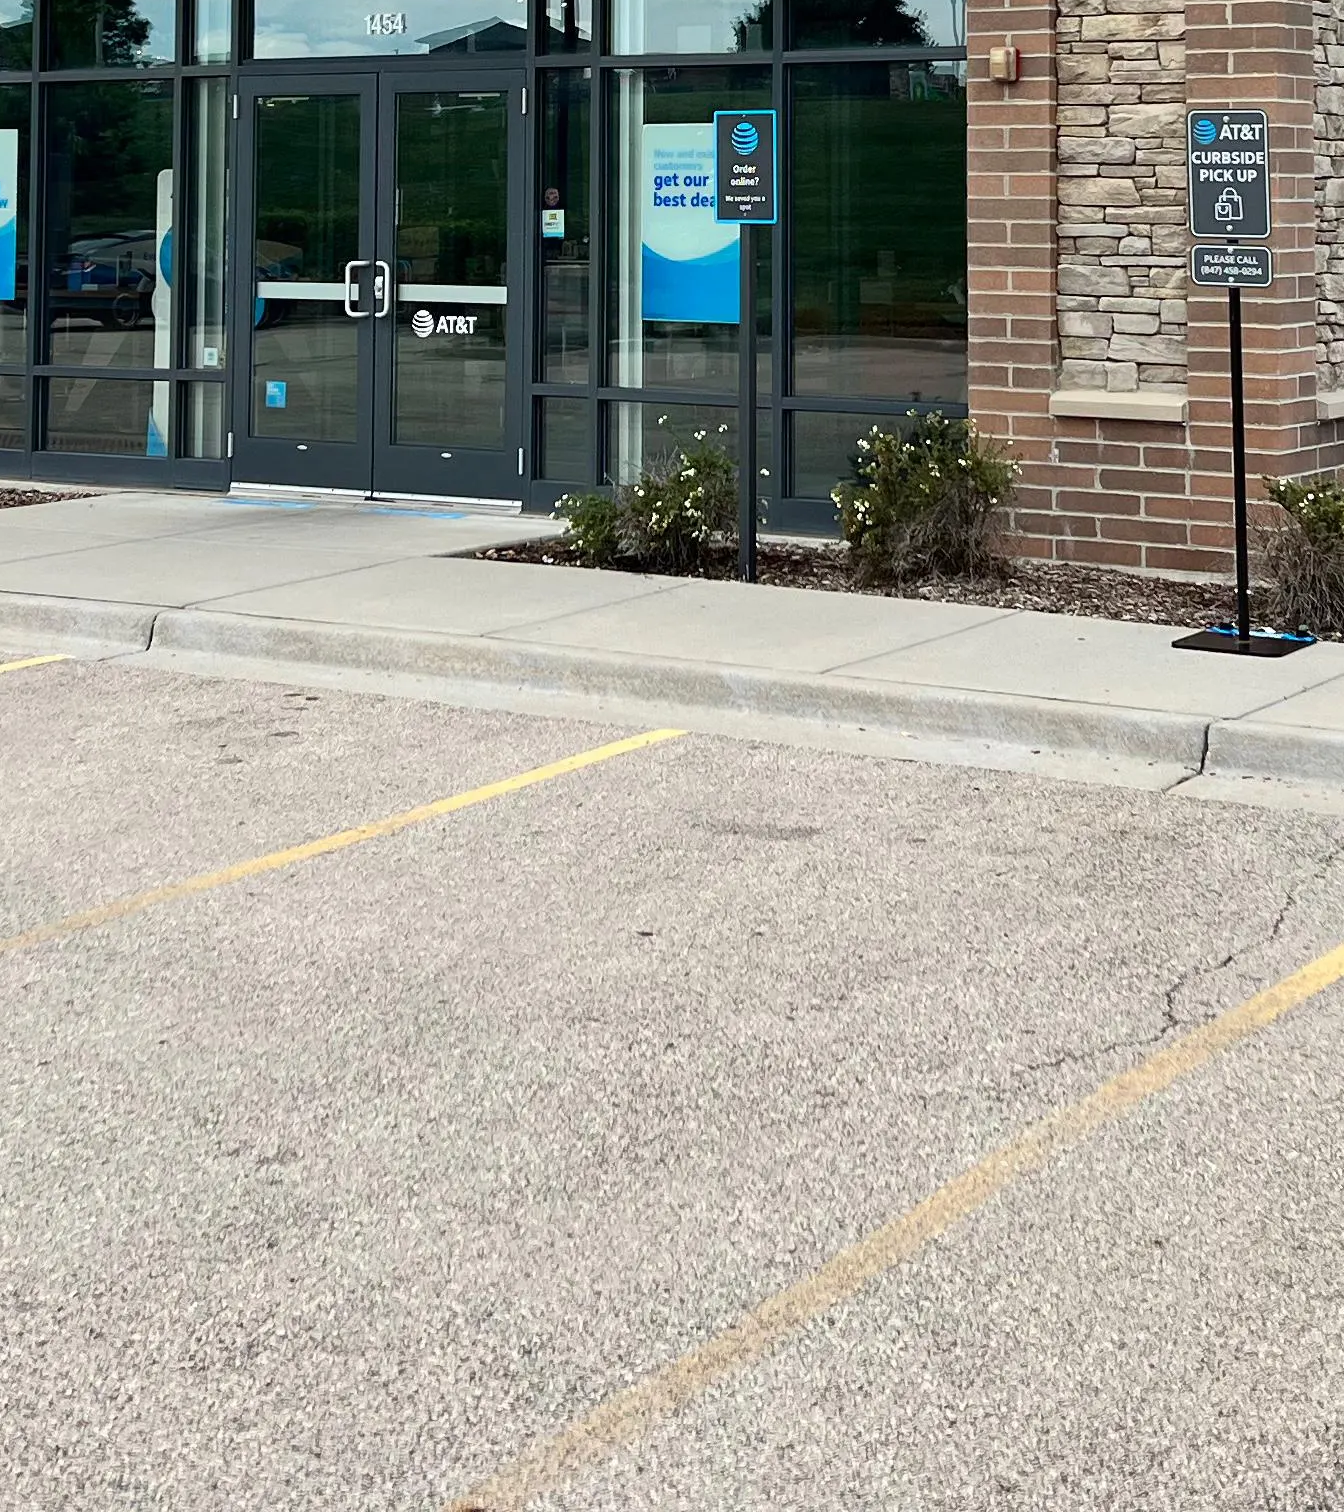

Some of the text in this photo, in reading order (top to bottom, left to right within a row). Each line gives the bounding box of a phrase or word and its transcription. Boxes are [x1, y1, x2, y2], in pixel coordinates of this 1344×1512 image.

[364, 13, 405, 35] 1454
[1219, 123, 1263, 140] AT&T
[1191, 151, 1265, 165] CURBSIDE
[732, 164, 757, 174] Order
[1199, 168, 1258, 182] PICK UP
[654, 173, 709, 190] get our
[730, 176, 760, 186] online?
[654, 191, 716, 207] best dea
[1203, 254, 1259, 265] PLEASE CALL
[1200, 265, 1222, 276] (847)
[435, 315, 478, 334] AT&T
